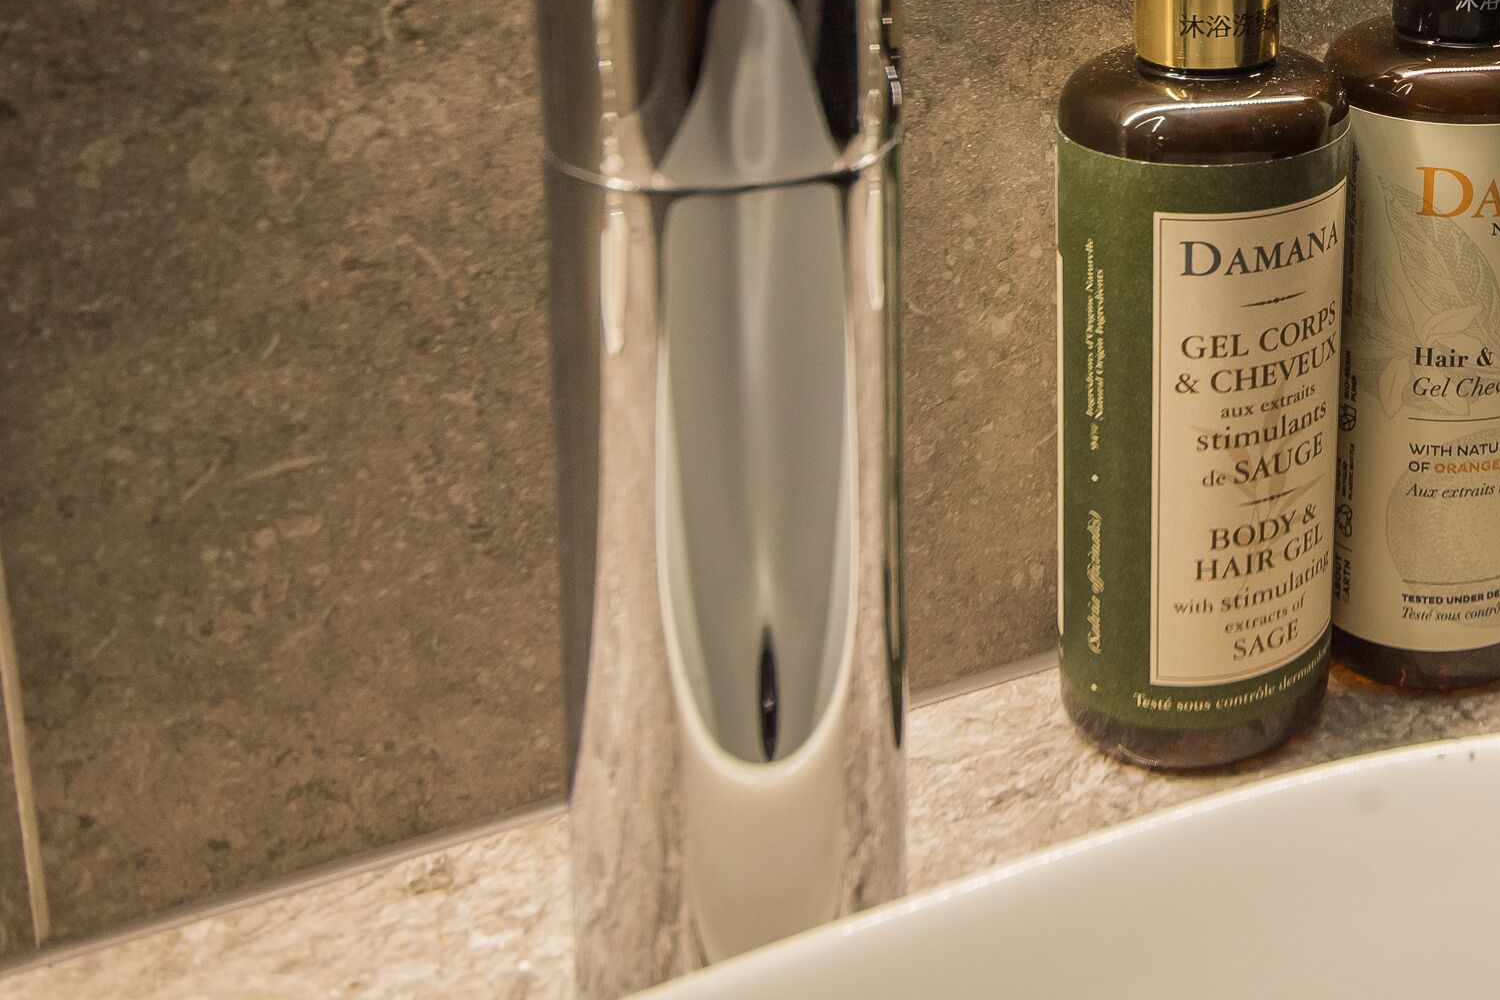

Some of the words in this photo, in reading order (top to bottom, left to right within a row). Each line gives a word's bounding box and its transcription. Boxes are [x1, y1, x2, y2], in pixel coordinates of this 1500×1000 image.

[1179, 220, 1338, 276] DAMANA
[1181, 333, 1249, 359] GEL
[1259, 300, 1336, 352] CORPS
[1175, 373, 1200, 394] &
[1210, 331, 1337, 394] CHEVEUX
[1414, 346, 1469, 368] Hair
[1476, 347, 1494, 367] &
[1220, 403, 1255, 419] aux
[1260, 383, 1316, 412] extraits
[1412, 376, 1451, 398] Gel
[1196, 400, 1327, 452] stimulants
[1202, 470, 1226, 487] de
[1233, 432, 1323, 485] SAUGE
[1408, 460, 1431, 473] OF
[1434, 460, 1500, 474] ORANGE
[1409, 442, 1451, 457] WITH
[1406, 482, 1438, 498] Aux
[1441, 482, 1495, 499] extraits
[1209, 509, 1297, 551] BODY
[1302, 503, 1317, 525] &
[1195, 549, 1276, 582] HAIR
[1283, 522, 1323, 561] GEL
[1174, 598, 1213, 616] with
[1220, 551, 1330, 613] stimulating
[1402, 593, 1444, 605] TESTED
[1446, 593, 1484, 605] UNDER
[1225, 609, 1288, 634] extracts
[1292, 590, 1307, 613] of
[1401, 606, 1432, 621] Testé
[1435, 609, 1461, 622] sous
[1232, 619, 1299, 661] SAGE
[1133, 692, 1172, 711] Testé
[1176, 700, 1211, 712] sous
[1215, 684, 1276, 710] contrôle
